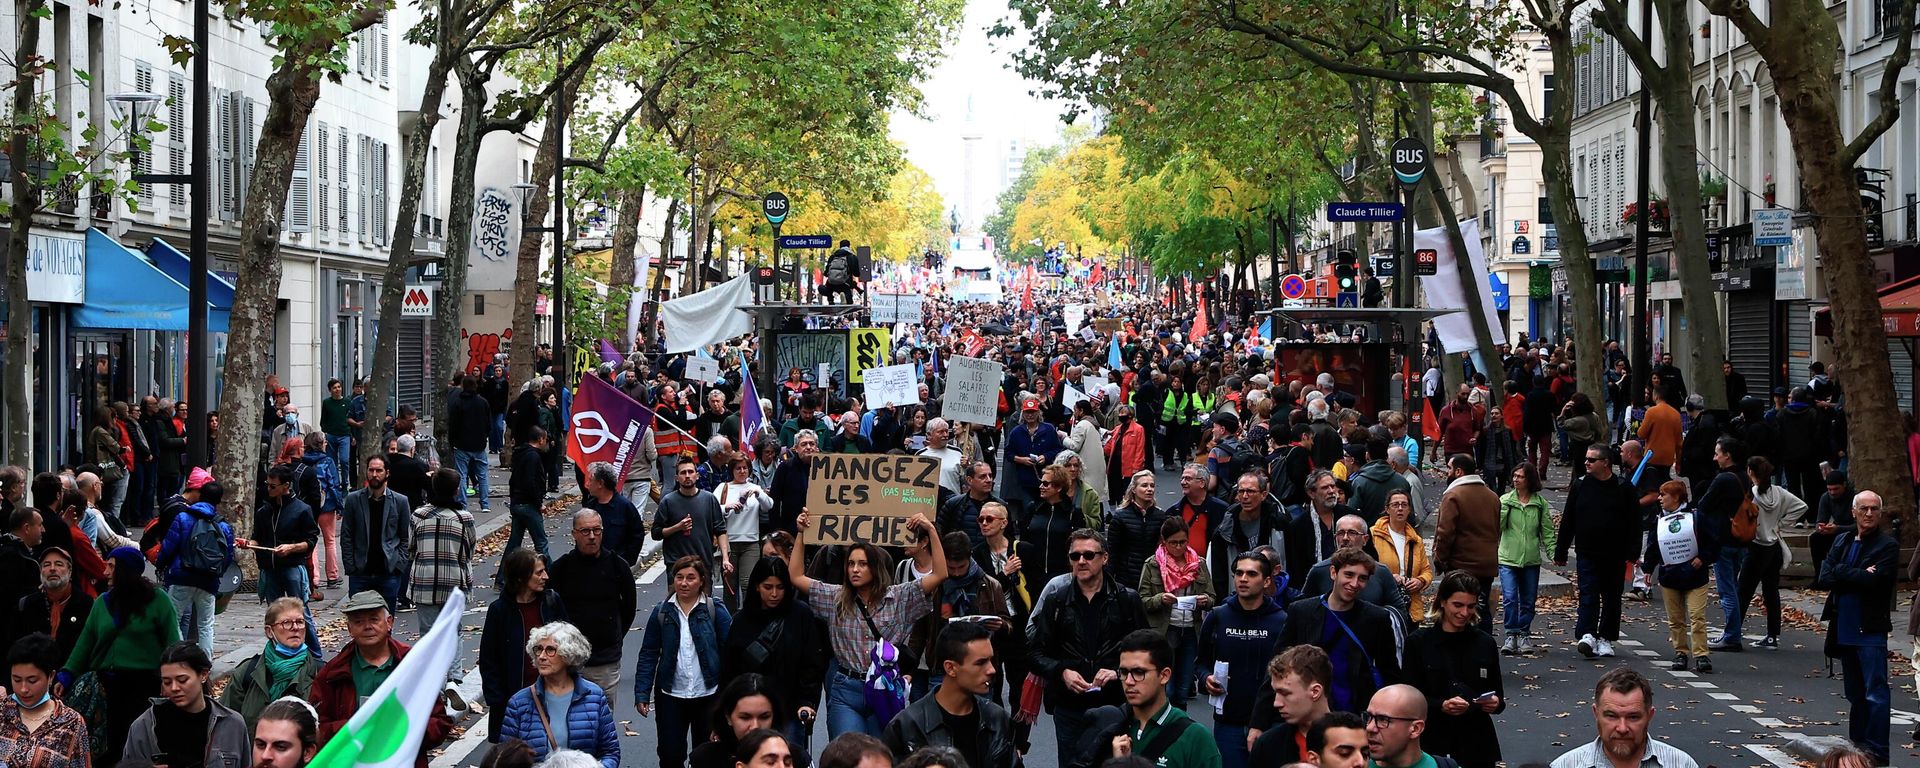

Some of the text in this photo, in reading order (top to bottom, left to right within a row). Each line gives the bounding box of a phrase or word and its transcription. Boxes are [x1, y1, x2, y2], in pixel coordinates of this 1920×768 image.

[1395, 149, 1424, 164] BUS
[766, 200, 785, 209] BUS
[1335, 208, 1396, 217] Claude Tillier
[33, 236, 43, 272] de
[45, 238, 83, 275] VOYAGES
[1419, 252, 1433, 262] 86
[958, 357, 992, 372] AUGMENTER
[971, 371, 983, 382] LES
[958, 380, 989, 394] SALAIRES
[958, 392, 986, 405] PAS LES
[947, 401, 994, 417] ACTIONNAIRES
[811, 456, 939, 488] MANGEZ
[825, 484, 870, 506] LES
[902, 488, 915, 496] LES
